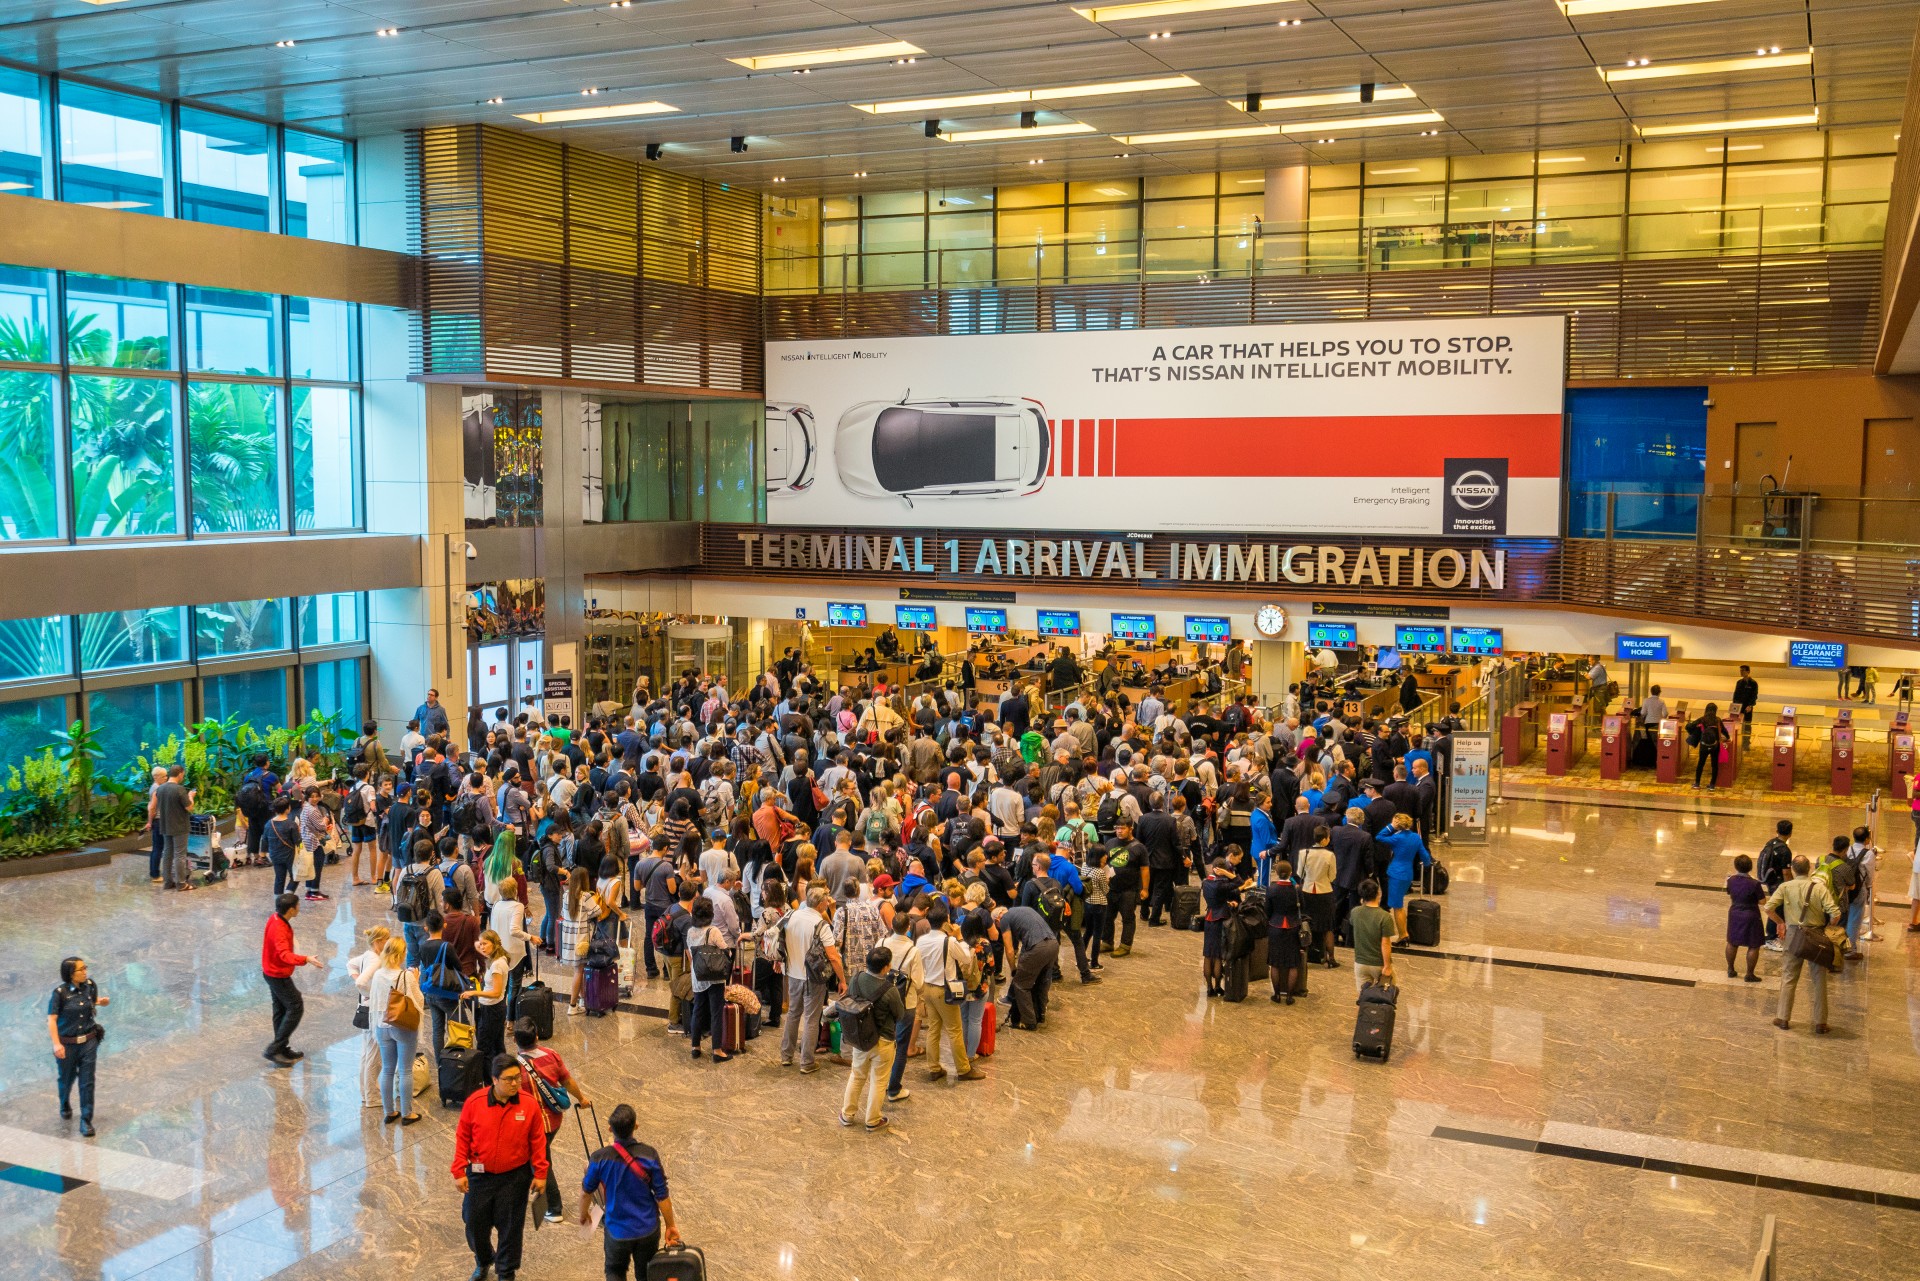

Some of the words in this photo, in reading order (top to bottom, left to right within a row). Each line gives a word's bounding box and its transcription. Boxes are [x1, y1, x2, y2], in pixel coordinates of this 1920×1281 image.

[1152, 346, 1166, 361] A
[1172, 344, 1214, 360] CAR
[1220, 342, 1274, 359] THAT
[1280, 340, 1350, 358] HELPS
[1356, 339, 1403, 356] YOU
[1410, 338, 1440, 354] TO
[1448, 336, 1512, 354] STOP.
[852, 350, 888, 359] MOBILITY
[1092, 366, 1160, 382] THAT'S
[1167, 364, 1244, 381] NISSAN
[1252, 361, 1391, 379] INTELLIGENT
[1397, 358, 1512, 376] MOBILITY.
[1354, 497, 1398, 505] Emergency
[738, 534, 934, 572] TERMINAL
[944, 539, 959, 573] 1
[974, 539, 1157, 578] ARRIVAL
[1170, 542, 1505, 590] IMMIGRATION
[1440, 677, 1452, 686] 15
[1003, 683, 1008, 691] 5
[1345, 703, 1358, 713] 13
